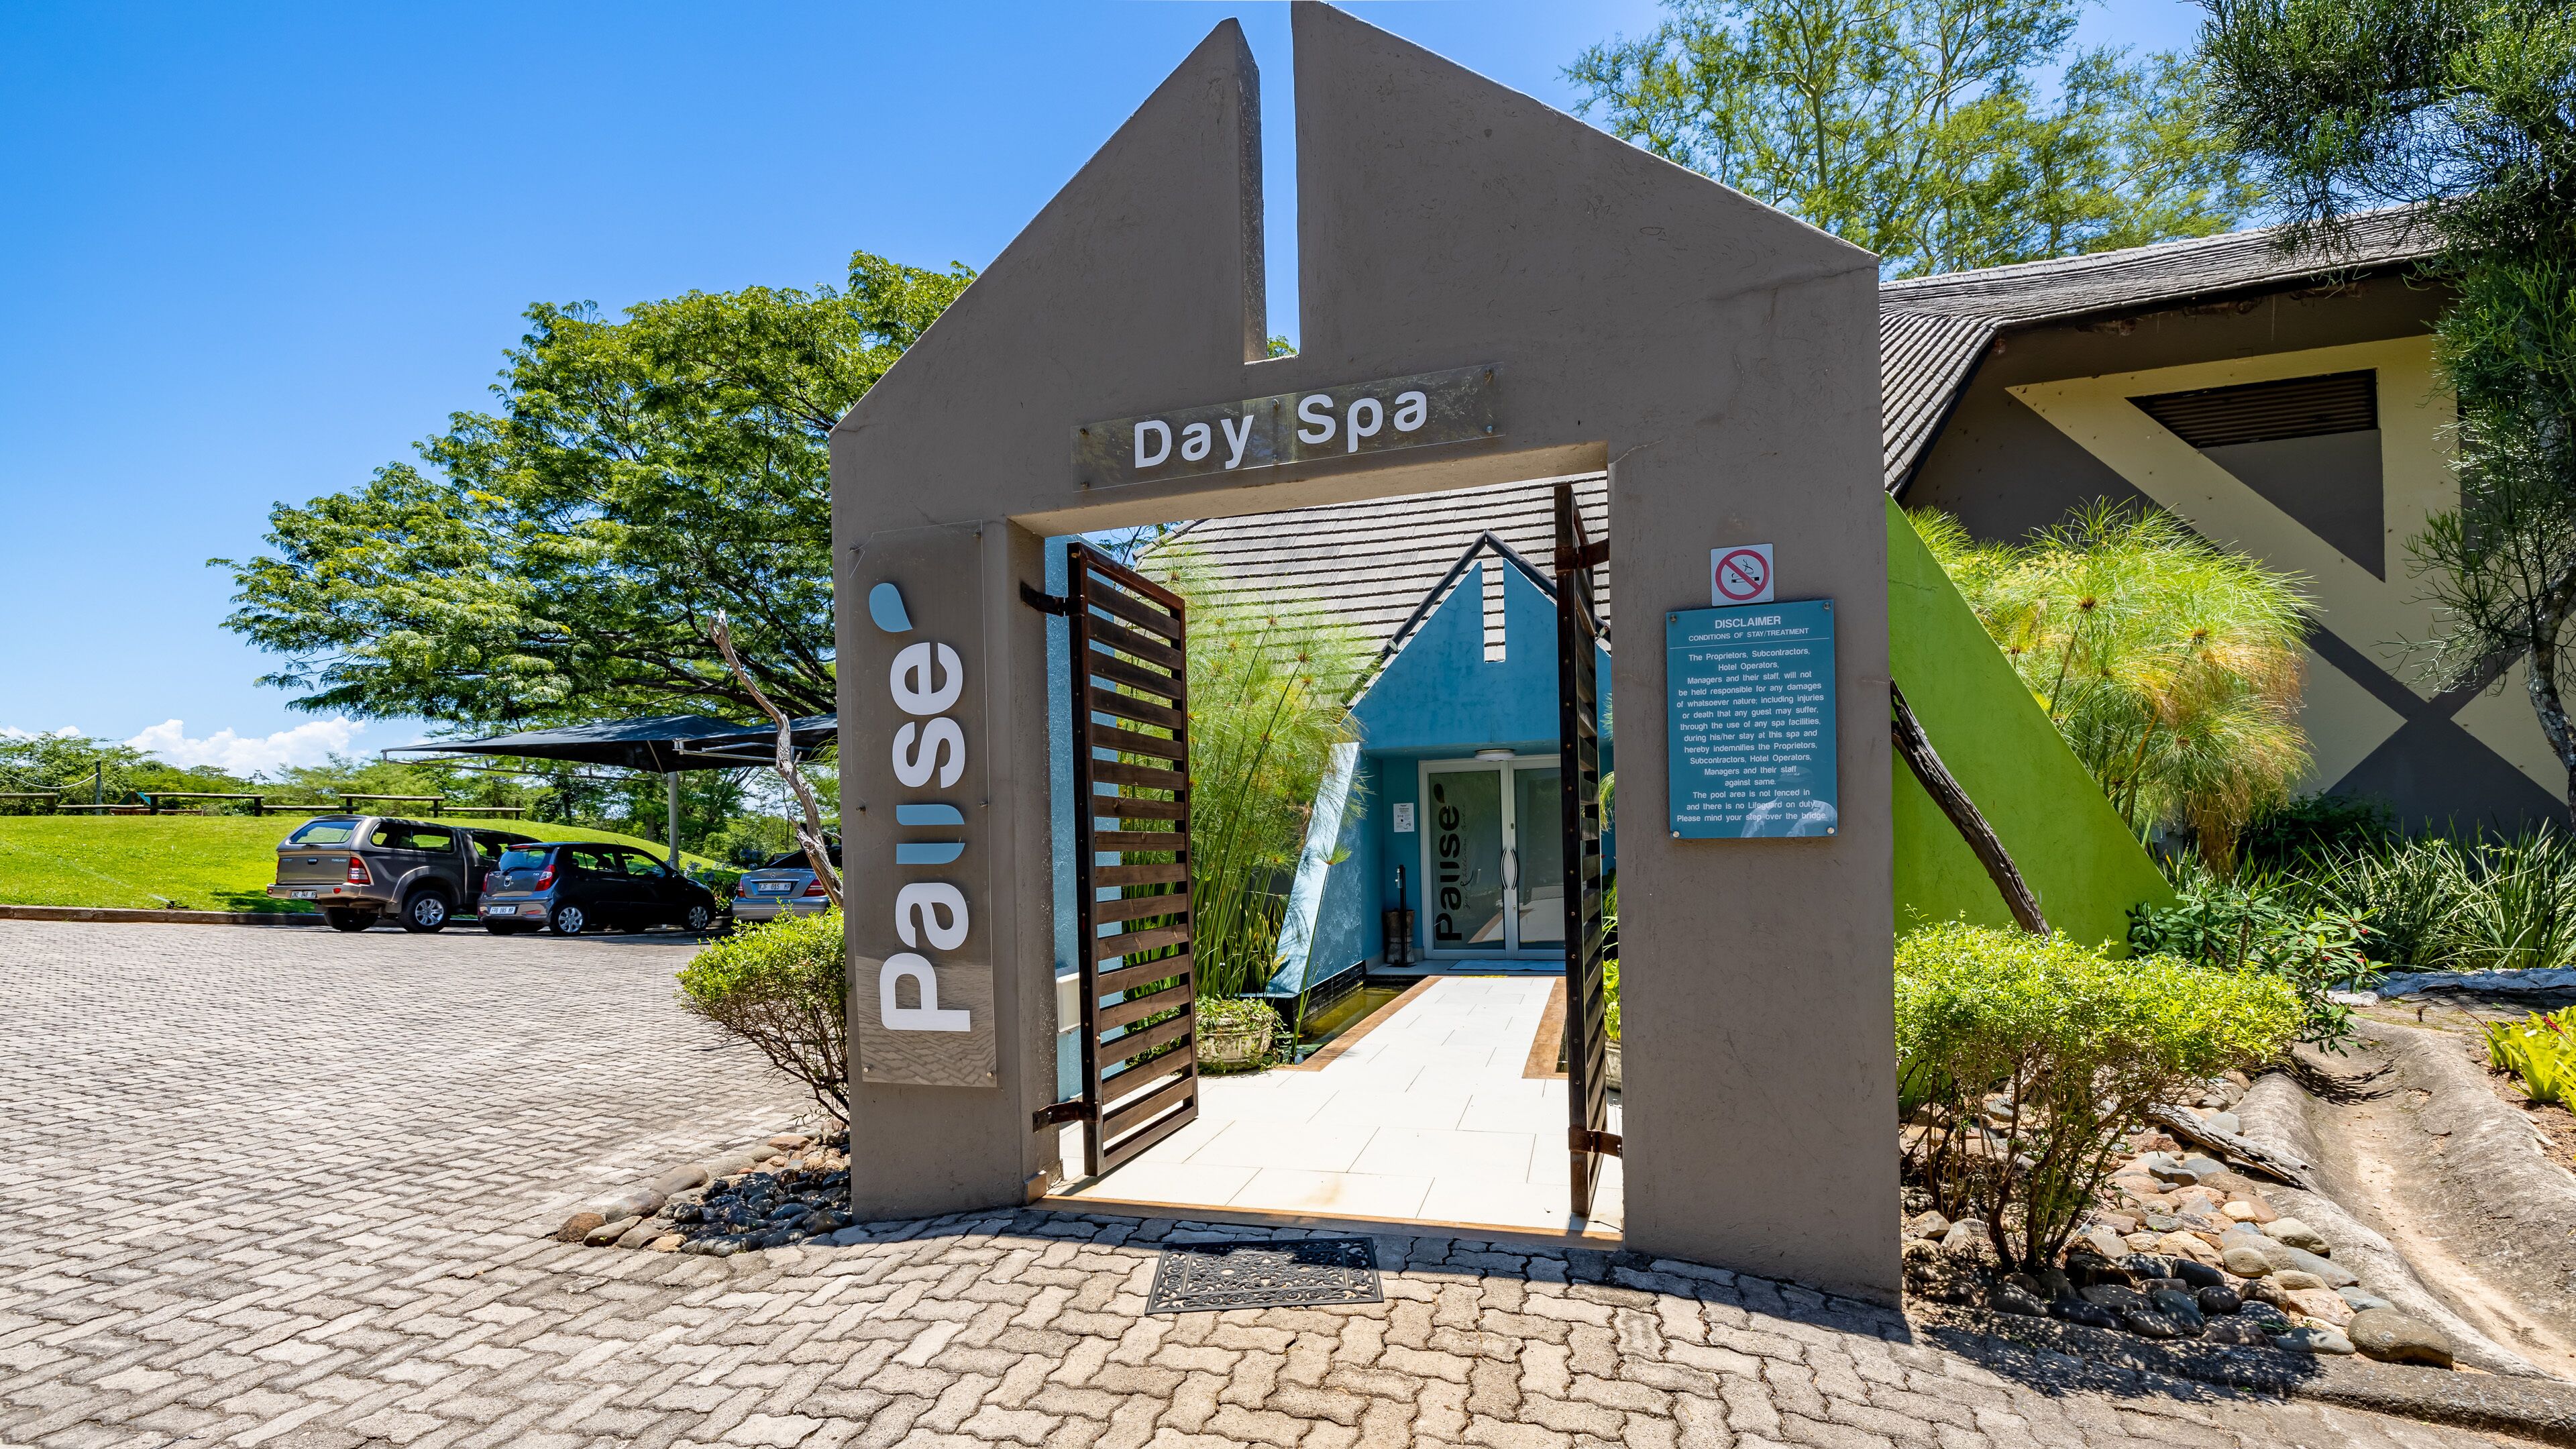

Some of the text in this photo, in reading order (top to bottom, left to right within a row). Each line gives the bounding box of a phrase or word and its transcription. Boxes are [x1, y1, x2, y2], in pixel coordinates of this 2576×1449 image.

[1134, 390, 1428, 470] Day Spa
[1715, 615, 1781, 629] DISCLAIMER
[1688, 633, 1731, 642] CONDITIONS
[1747, 627, 1809, 638] STAY/TREATMENT
[1706, 651, 1748, 661] Proprietors,
[1752, 647, 1810, 657] Subcontractors,
[1718, 661, 1779, 672] Hotel Operators,
[1687, 670, 1812, 686] Managers and their staff, will not
[1690, 688, 1707, 696] held
[1710, 686, 1753, 696] responsible
[1770, 685, 1783, 693] any
[1786, 683, 1822, 692] damages
[1676, 694, 1825, 708] of whatsoever nature; including injuries
[1693, 710, 1714, 718] death
[1717, 709, 1731, 717] that
[1734, 710, 1748, 718] any
[1751, 708, 1772, 718] guest
[1775, 708, 1792, 716] may
[1795, 706, 1819, 714] suffer,
[1680, 722, 1709, 732] through
[1743, 720, 1751, 728] of
[1754, 720, 1768, 729] any
[1771, 720, 1785, 729] spa
[1788, 717, 1821, 726] facilities,
[1684, 734, 1707, 743] during
[1709, 733, 1735, 741] his/her
[1739, 732, 1755, 741] stay
[1768, 731, 1782, 739] this
[1786, 731, 1800, 739] spa
[1684, 741, 1817, 755] hereby indemnifies the Proprietors,
[1690, 753, 1812, 765] Subcontractors, Hotel Operators,
[1704, 768, 1740, 777] Managers
[1725, 778, 1751, 788] against
[1693, 791, 1707, 799] The
[1710, 791, 1726, 800] pool
[1749, 790, 1756, 798] is
[1774, 788, 1800, 796] fenced
[1686, 803, 1700, 811] and
[1725, 802, 1732, 810] is
[1748, 800, 1782, 810] Lifeguard
[1704, 814, 1723, 822] mind
[1725, 814, 1742, 823] your
[1746, 812, 1762, 822] step
